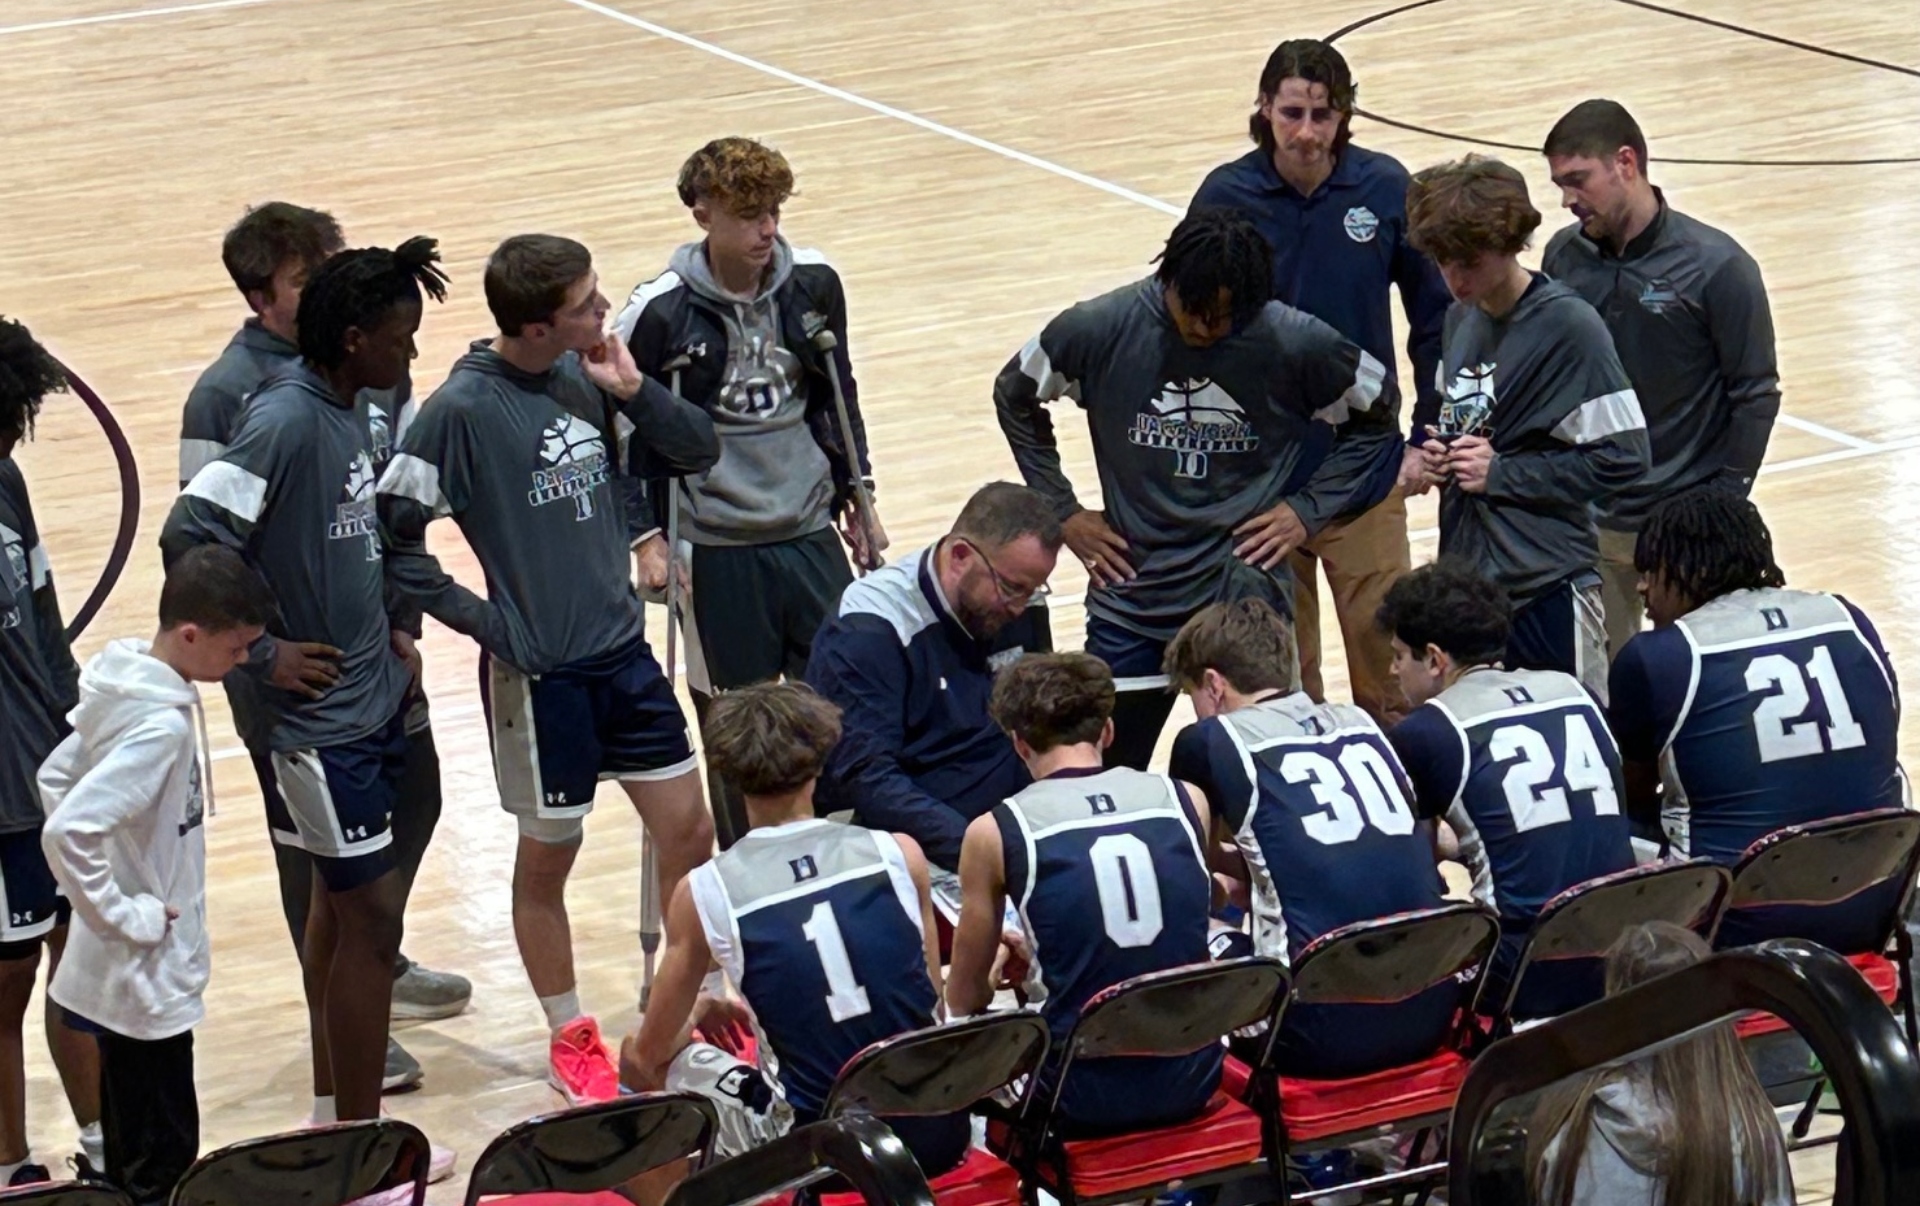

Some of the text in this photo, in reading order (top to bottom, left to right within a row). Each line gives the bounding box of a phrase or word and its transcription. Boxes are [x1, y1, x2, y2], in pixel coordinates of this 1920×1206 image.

[1760, 607, 1789, 631] D
[1744, 645, 1866, 763] 21
[1085, 794, 1117, 815] D
[1280, 742, 1415, 845] 30
[1489, 714, 1620, 833] 24
[788, 855, 818, 883] D
[1089, 833, 1164, 948] 0
[802, 900, 872, 1023] 1
